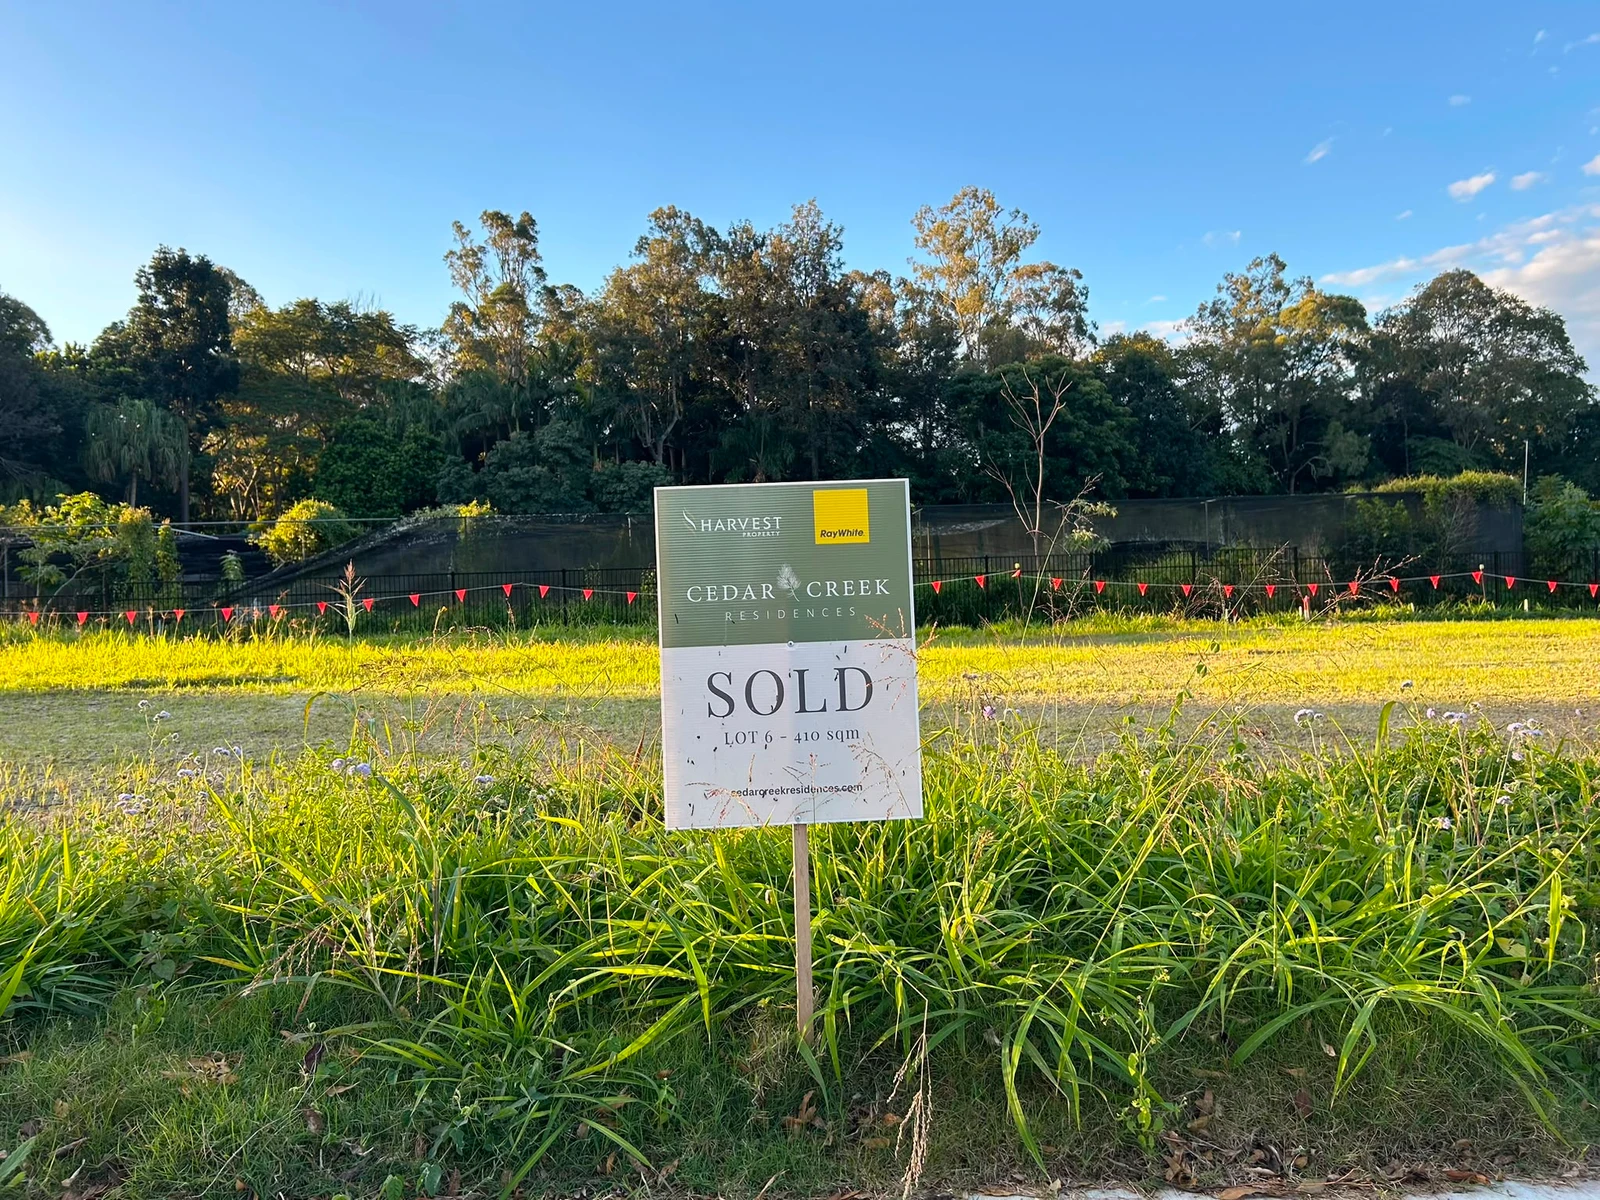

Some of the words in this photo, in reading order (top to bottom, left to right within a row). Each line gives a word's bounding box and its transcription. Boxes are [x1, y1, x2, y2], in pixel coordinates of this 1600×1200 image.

[701, 516, 782, 532] HARVEST
[687, 584, 776, 602] CEDAR
[807, 579, 890, 598] CREEK
[725, 607, 856, 621] RESIDENCES
[707, 666, 873, 718] SOLD
[724, 731, 758, 746] LOT
[764, 730, 773, 744] 6
[794, 730, 820, 743] 410
[827, 727, 860, 741] sqm
